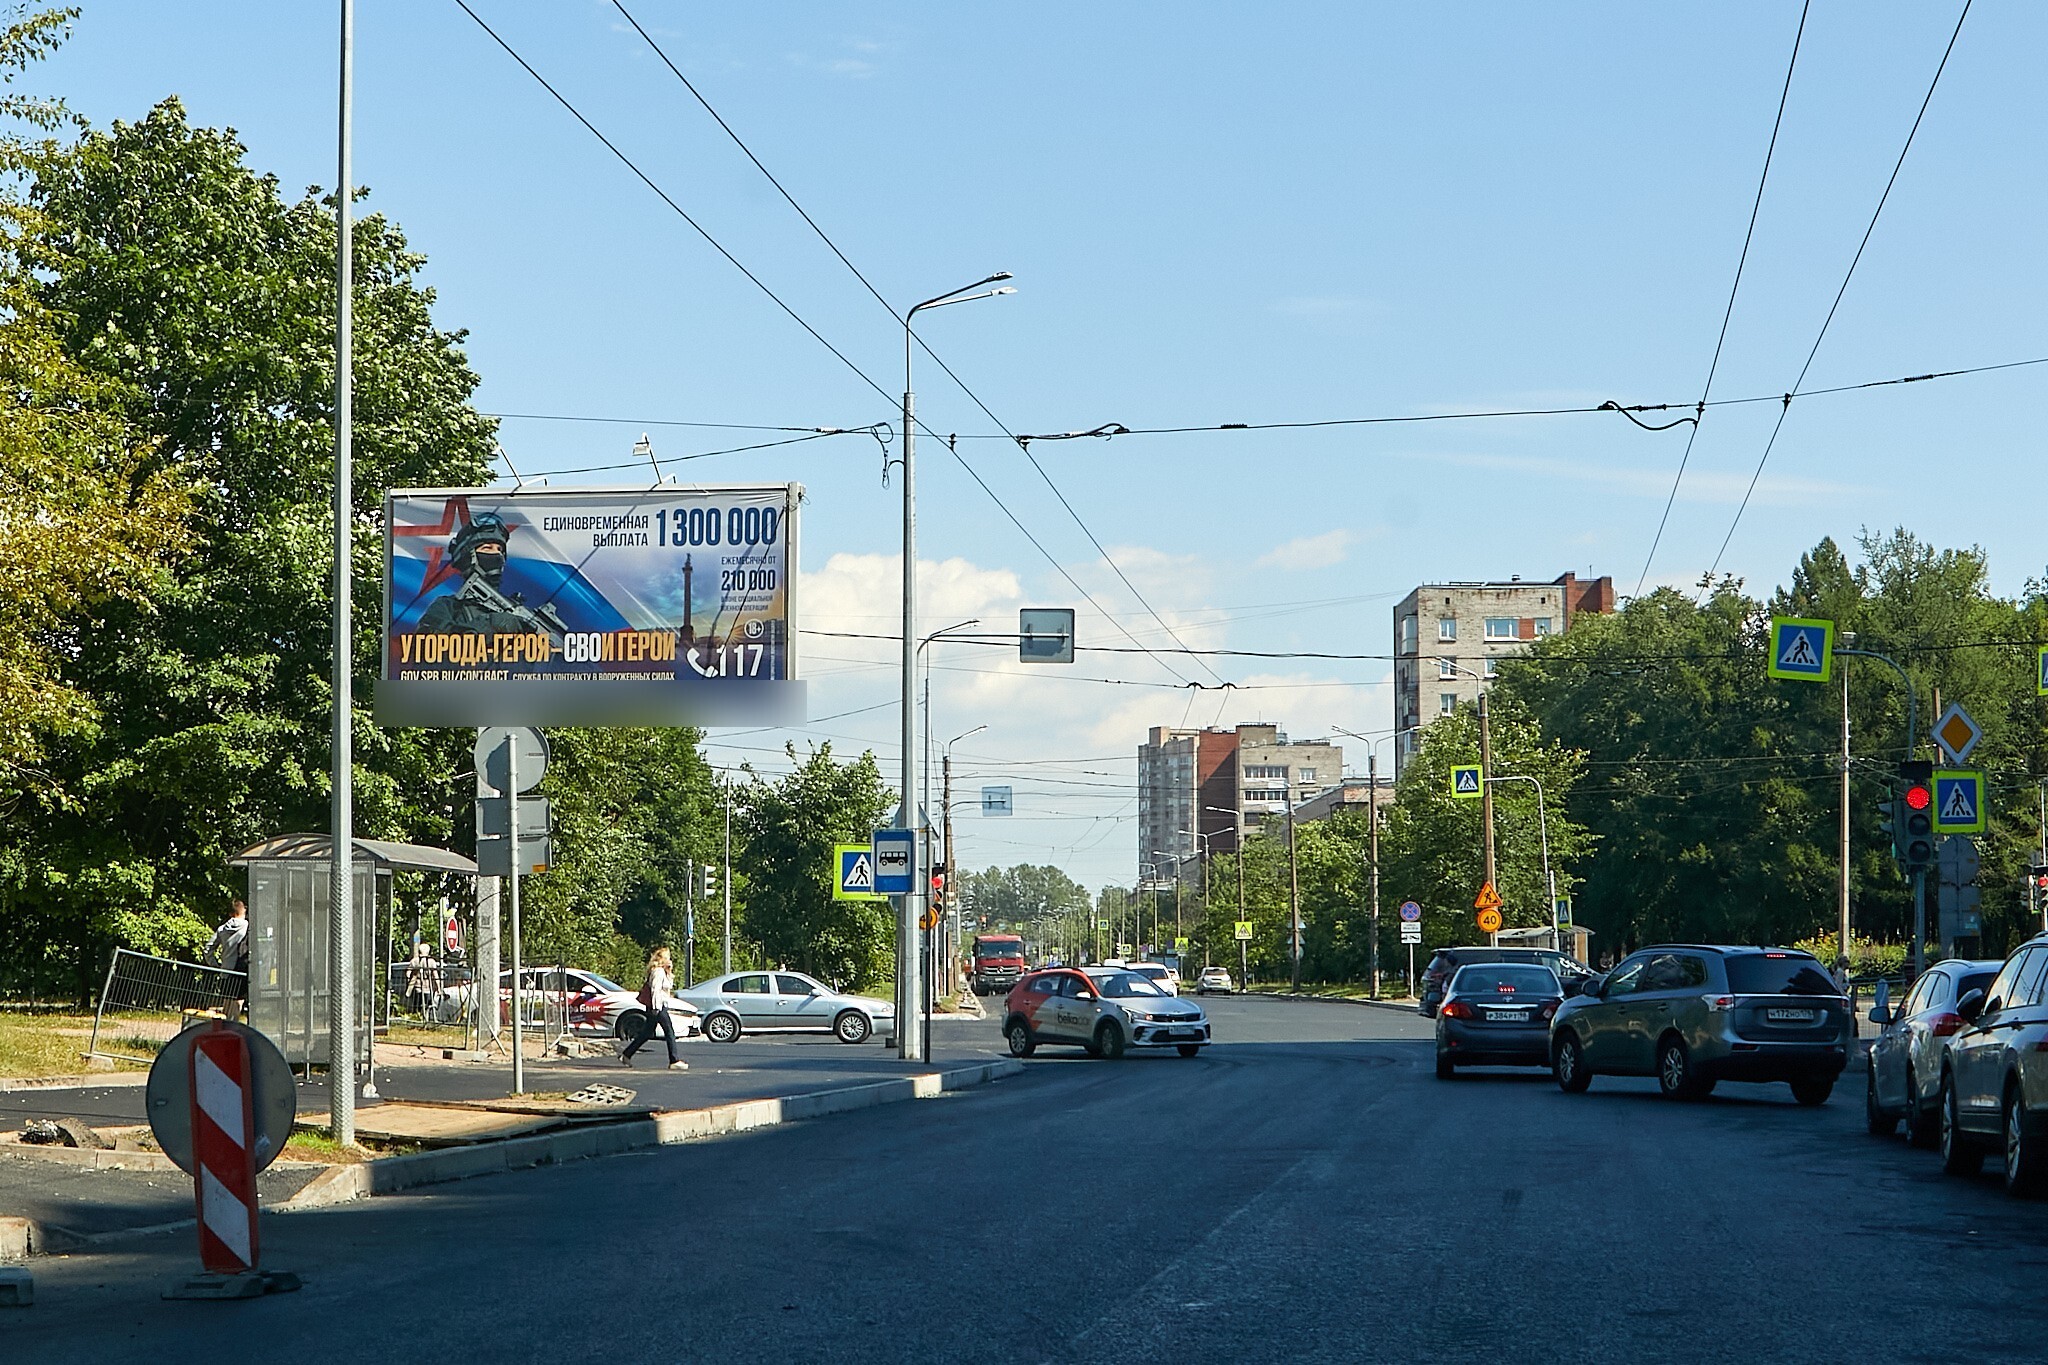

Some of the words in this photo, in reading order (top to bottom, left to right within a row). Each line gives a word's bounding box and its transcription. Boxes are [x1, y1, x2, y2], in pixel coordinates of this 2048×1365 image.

[544, 515, 648, 532] ЕДИНОВРЕМЕННАЯ
[656, 509, 666, 546] 1
[672, 507, 721, 546] 300
[727, 506, 777, 546] 000
[593, 532, 648, 547] ВЫПЛАТА
[721, 556, 766, 565] ЕЖЕМЕСЯЧНО
[767, 555, 776, 564] ОТ
[721, 569, 745, 591] 210
[749, 569, 776, 590] 000
[748, 622, 762, 635] 18+
[400, 633, 412, 663] У
[415, 632, 549, 666] ГОРОДА-ГЕРОЯ
[563, 631, 614, 662] СВОИ
[617, 630, 676, 662] ГЕРОИ
[717, 644, 764, 677] 117
[400, 669, 509, 680] GOVSPBRU/CONTRACT
[1483, 915, 1497, 925] 40
